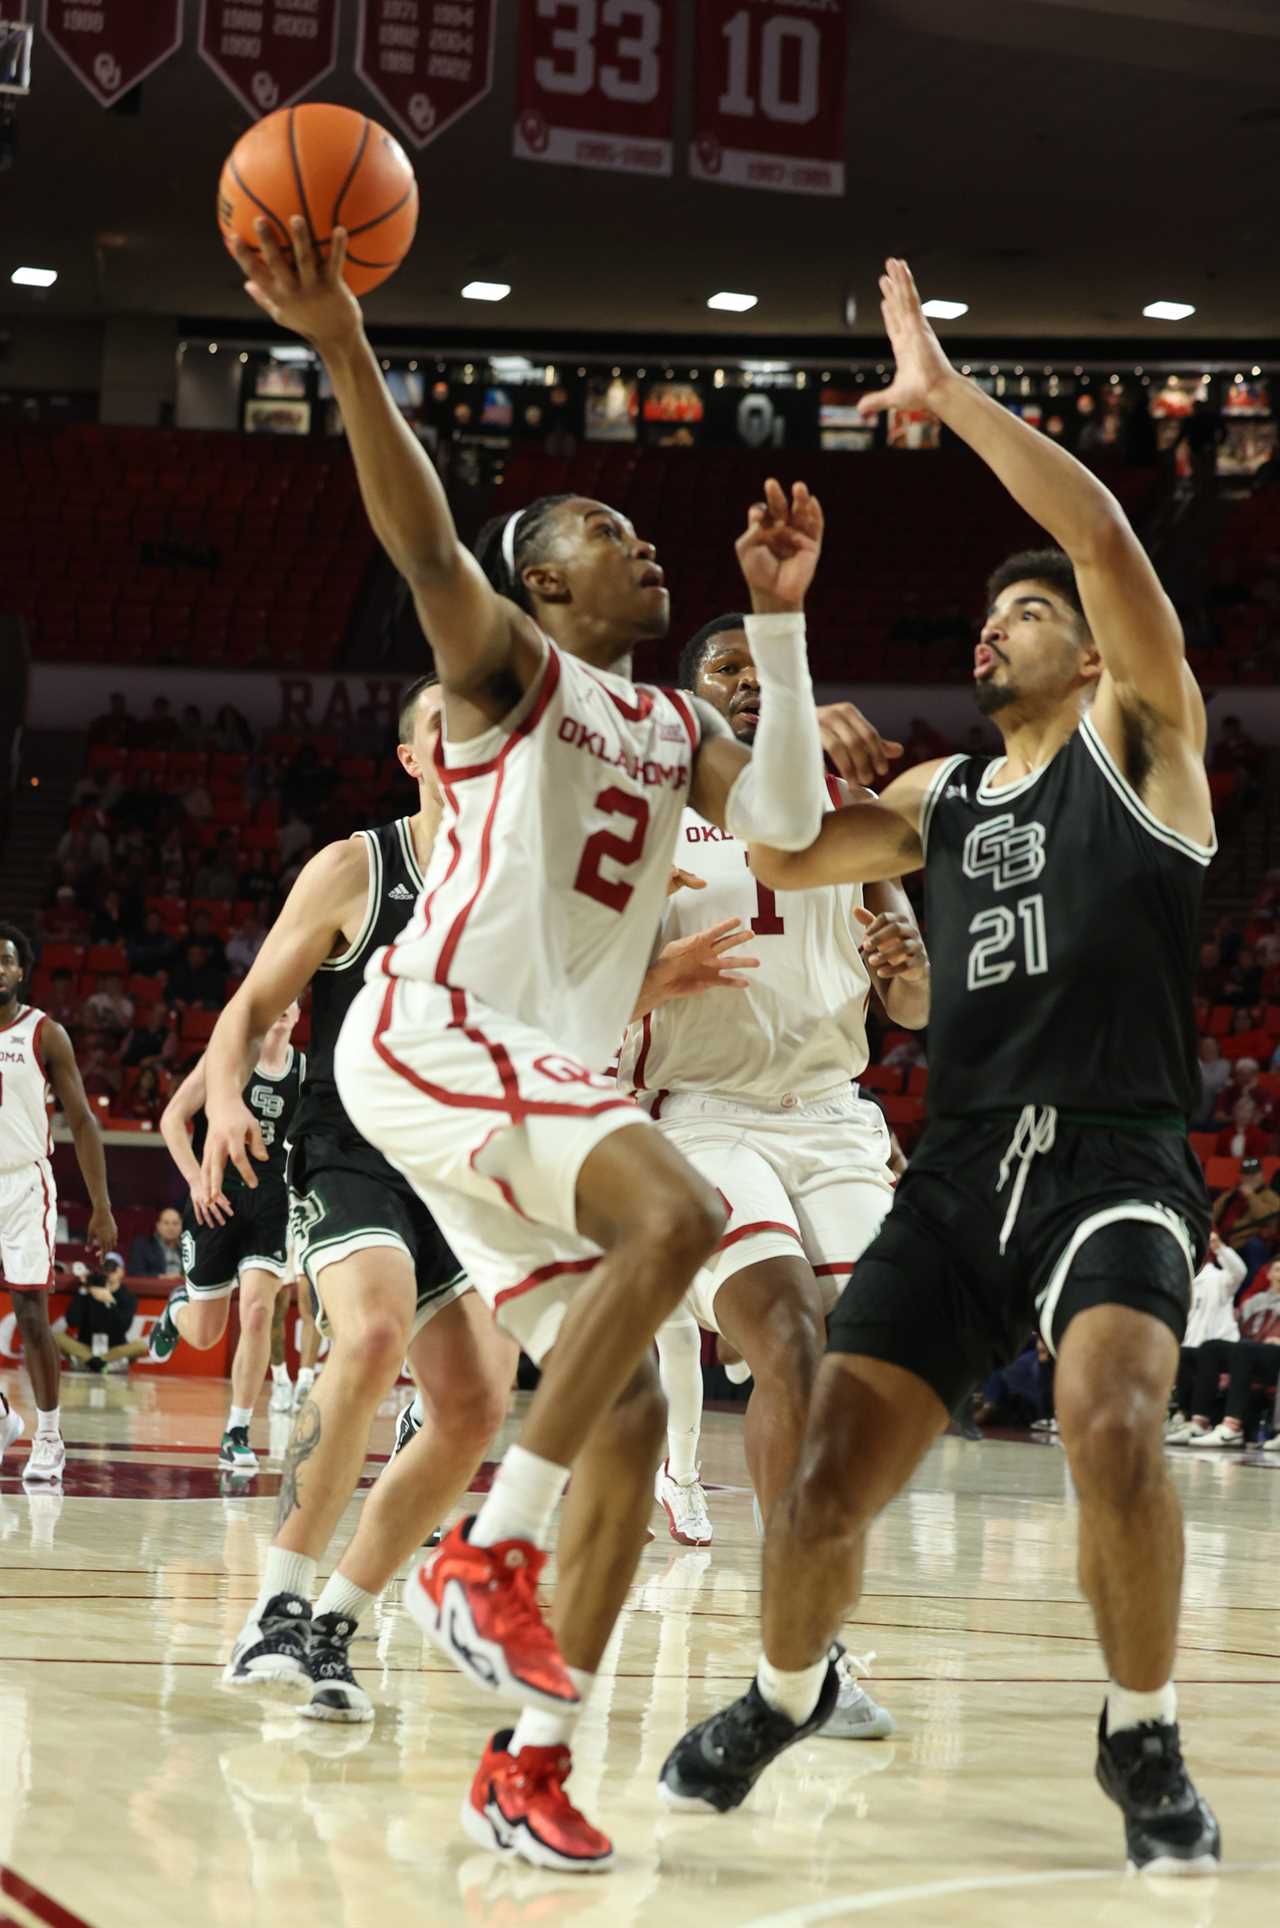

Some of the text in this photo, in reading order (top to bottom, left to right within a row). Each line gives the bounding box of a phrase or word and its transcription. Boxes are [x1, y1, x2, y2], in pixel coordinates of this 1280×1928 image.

[535, 0, 661, 103] 33
[718, 10, 821, 125] 10
[573, 785, 650, 914] 2
[962, 813, 1046, 892] GB
[967, 894, 1049, 992] 21
[250, 1084, 285, 1119] GB
